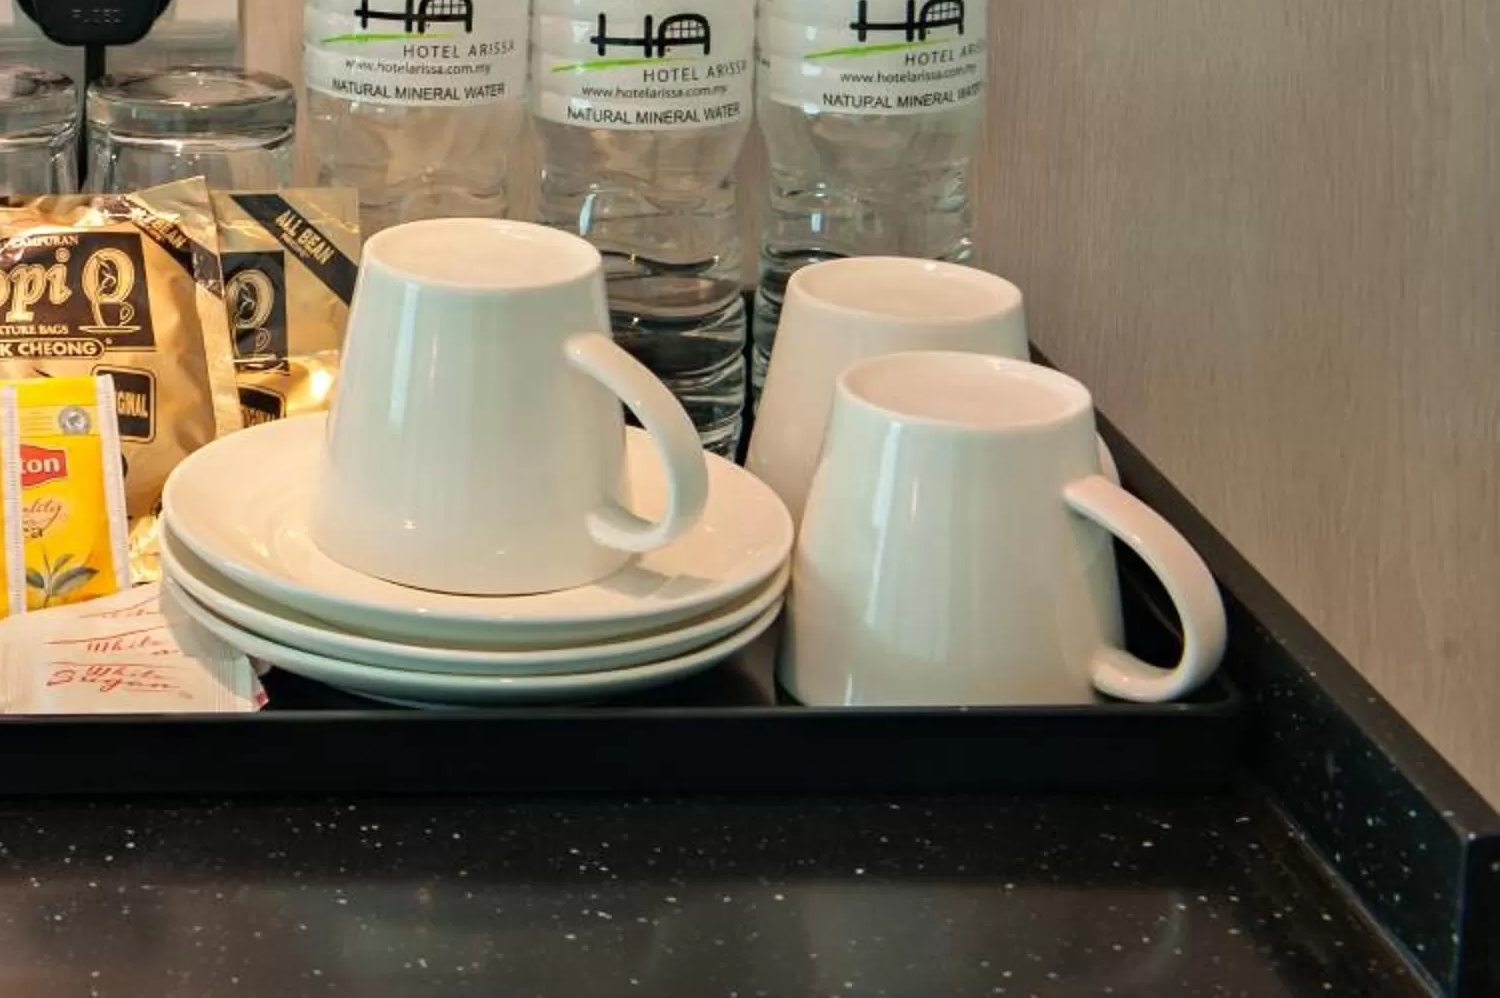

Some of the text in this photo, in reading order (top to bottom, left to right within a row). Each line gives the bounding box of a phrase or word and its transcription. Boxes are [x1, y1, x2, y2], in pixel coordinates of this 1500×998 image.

[403, 39, 515, 59] HOTEL ARISSA
[905, 49, 954, 67] HOTEL
[643, 68, 699, 83] HOTEL
[332, 78, 506, 100] NATURAL MINERAL WATER
[822, 92, 893, 109] NATURAL
[896, 88, 954, 108] MINERAL
[567, 102, 741, 125] NATURAL MINERAL WATER
[276, 209, 303, 238] ALL
[298, 228, 335, 265] BEAN
[39, 325, 69, 335] BAGS
[18, 340, 98, 357] CHEONG
[20, 457, 60, 475] ton
